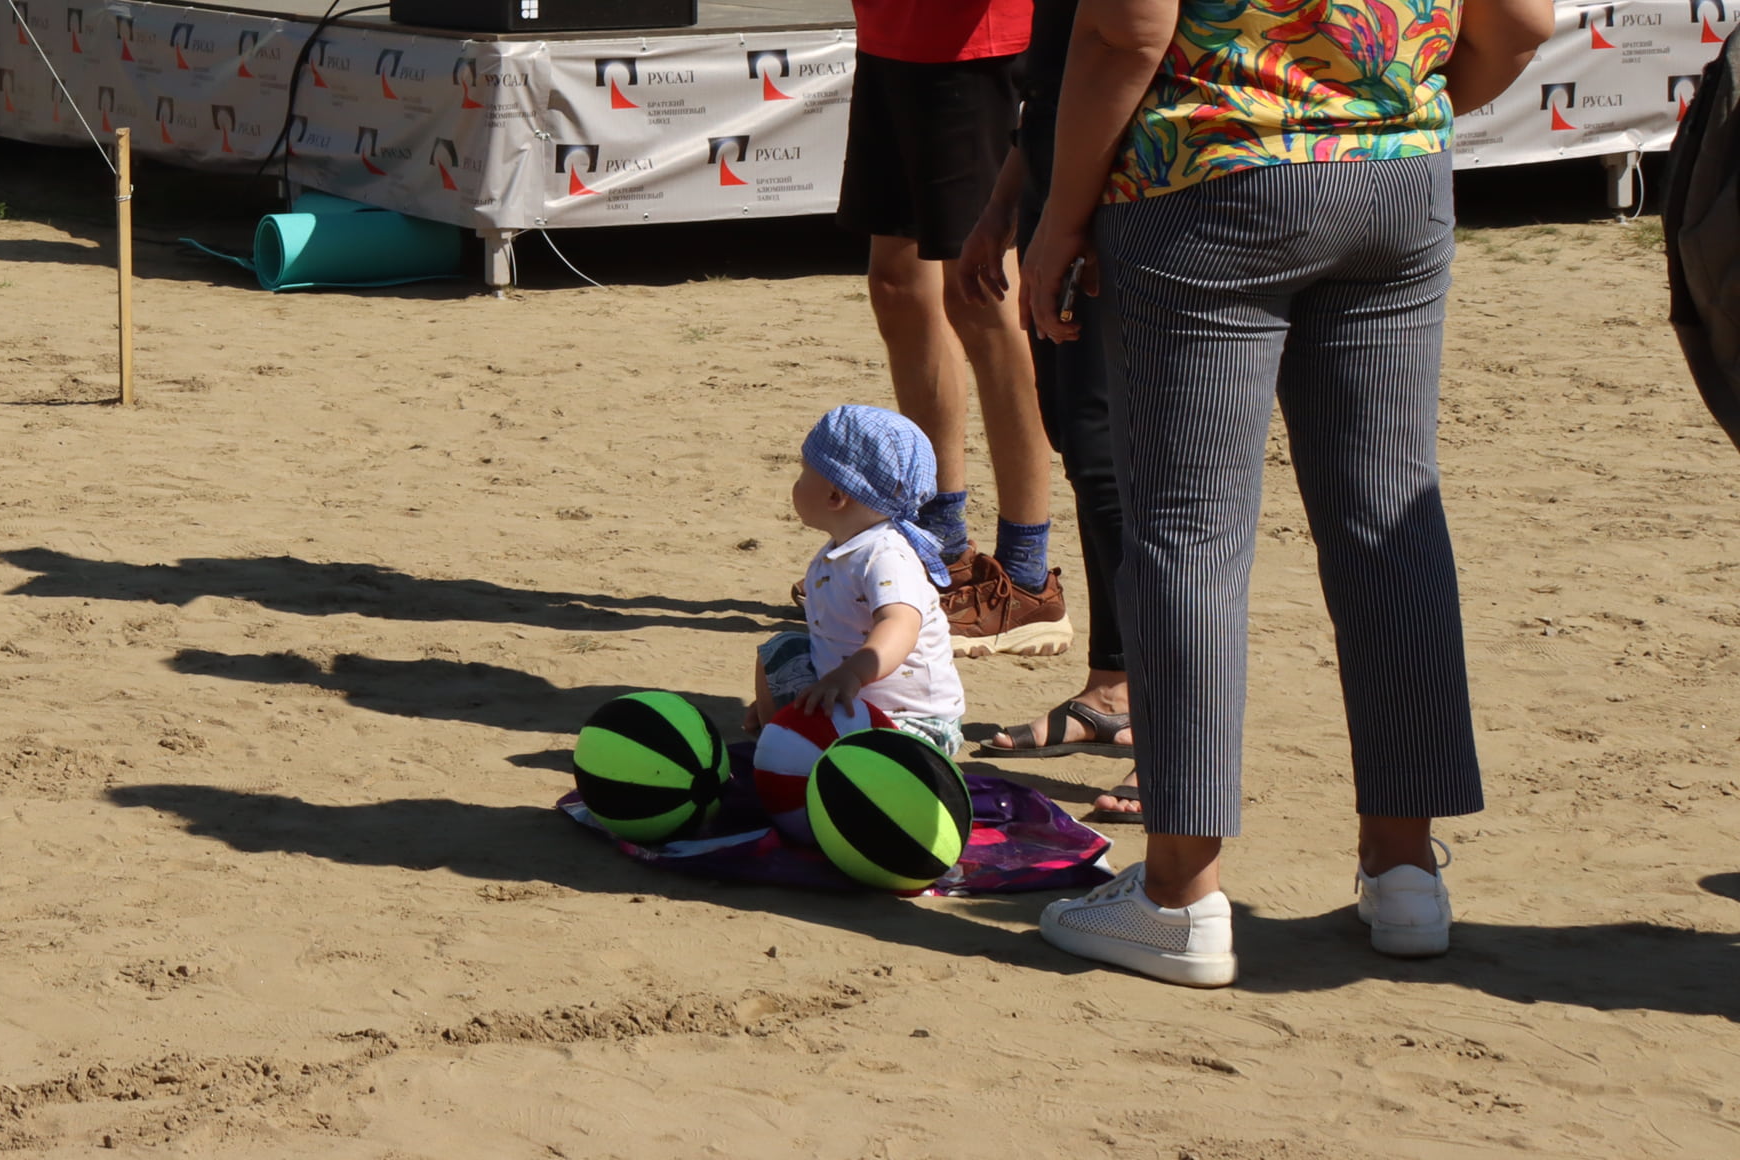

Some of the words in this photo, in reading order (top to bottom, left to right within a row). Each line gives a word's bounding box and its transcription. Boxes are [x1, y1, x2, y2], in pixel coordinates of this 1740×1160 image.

[1622, 12, 1662, 27] РУСАЛ
[799, 61, 847, 77] РУСАЛ
[647, 70, 694, 85] РУСАЛ
[1582, 94, 1623, 108] РУСАЛ
[755, 146, 801, 162] РУСАЛ
[606, 157, 653, 173] РУСАЛ
